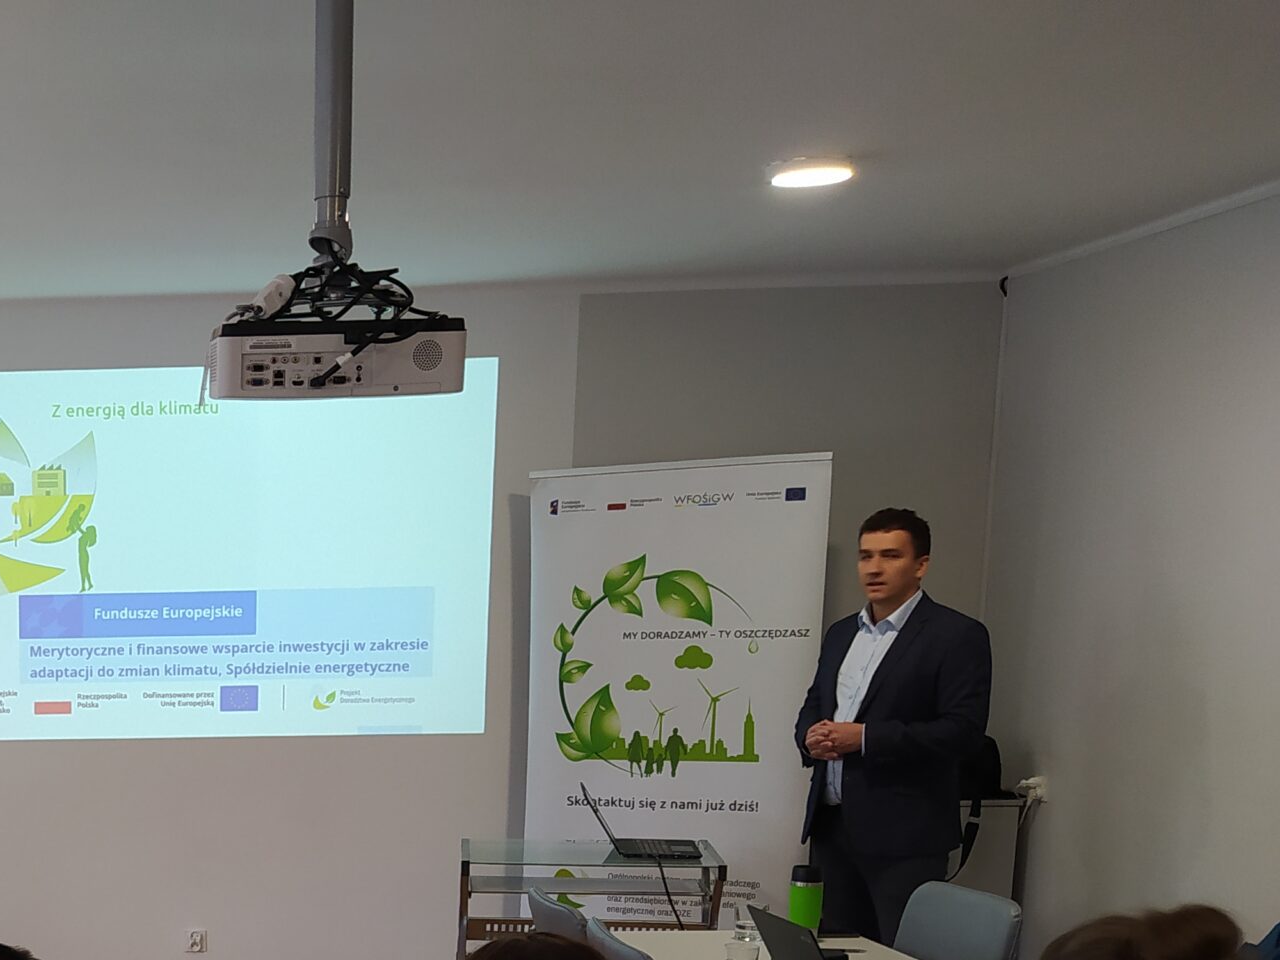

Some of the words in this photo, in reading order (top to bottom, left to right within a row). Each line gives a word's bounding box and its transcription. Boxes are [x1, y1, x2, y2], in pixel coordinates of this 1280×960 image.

[51, 404, 62, 418] Z
[66, 402, 126, 420] energią
[130, 401, 154, 417] dla
[158, 400, 220, 416] klimatu
[94, 606, 159, 620] Fundusze
[162, 604, 244, 622] Europejskie
[622, 631, 638, 640] MY
[640, 630, 708, 640] DORADZAMY
[719, 629, 732, 639] TY
[733, 628, 811, 641] OSZCZĘDZASZ
[29, 644, 125, 661] Merytoryczne
[128, 643, 133, 656] i
[136, 642, 209, 656] finansowe
[212, 641, 275, 658] wsparcie
[278, 638, 350, 656] inwestycji
[354, 641, 366, 652] w
[369, 638, 429, 652] zakresie
[29, 665, 94, 682] adaptacji
[97, 664, 115, 679] do
[118, 664, 160, 678] zmian
[164, 663, 222, 678] klimatu,
[225, 661, 311, 679] Spółdzielnie
[314, 661, 411, 677] energetyczne
[77, 692, 128, 700] Rzeczpospolita
[142, 691, 195, 699] Dofinansowane
[195, 691, 215, 699] przez
[77, 701, 100, 709] Polska
[638, 797, 656, 811] się
[659, 799, 667, 810] z
[670, 798, 702, 811] nami
[704, 799, 726, 814] już
[728, 797, 759, 813] dziś!
[624, 895, 679, 906] przedsiębiorsw
